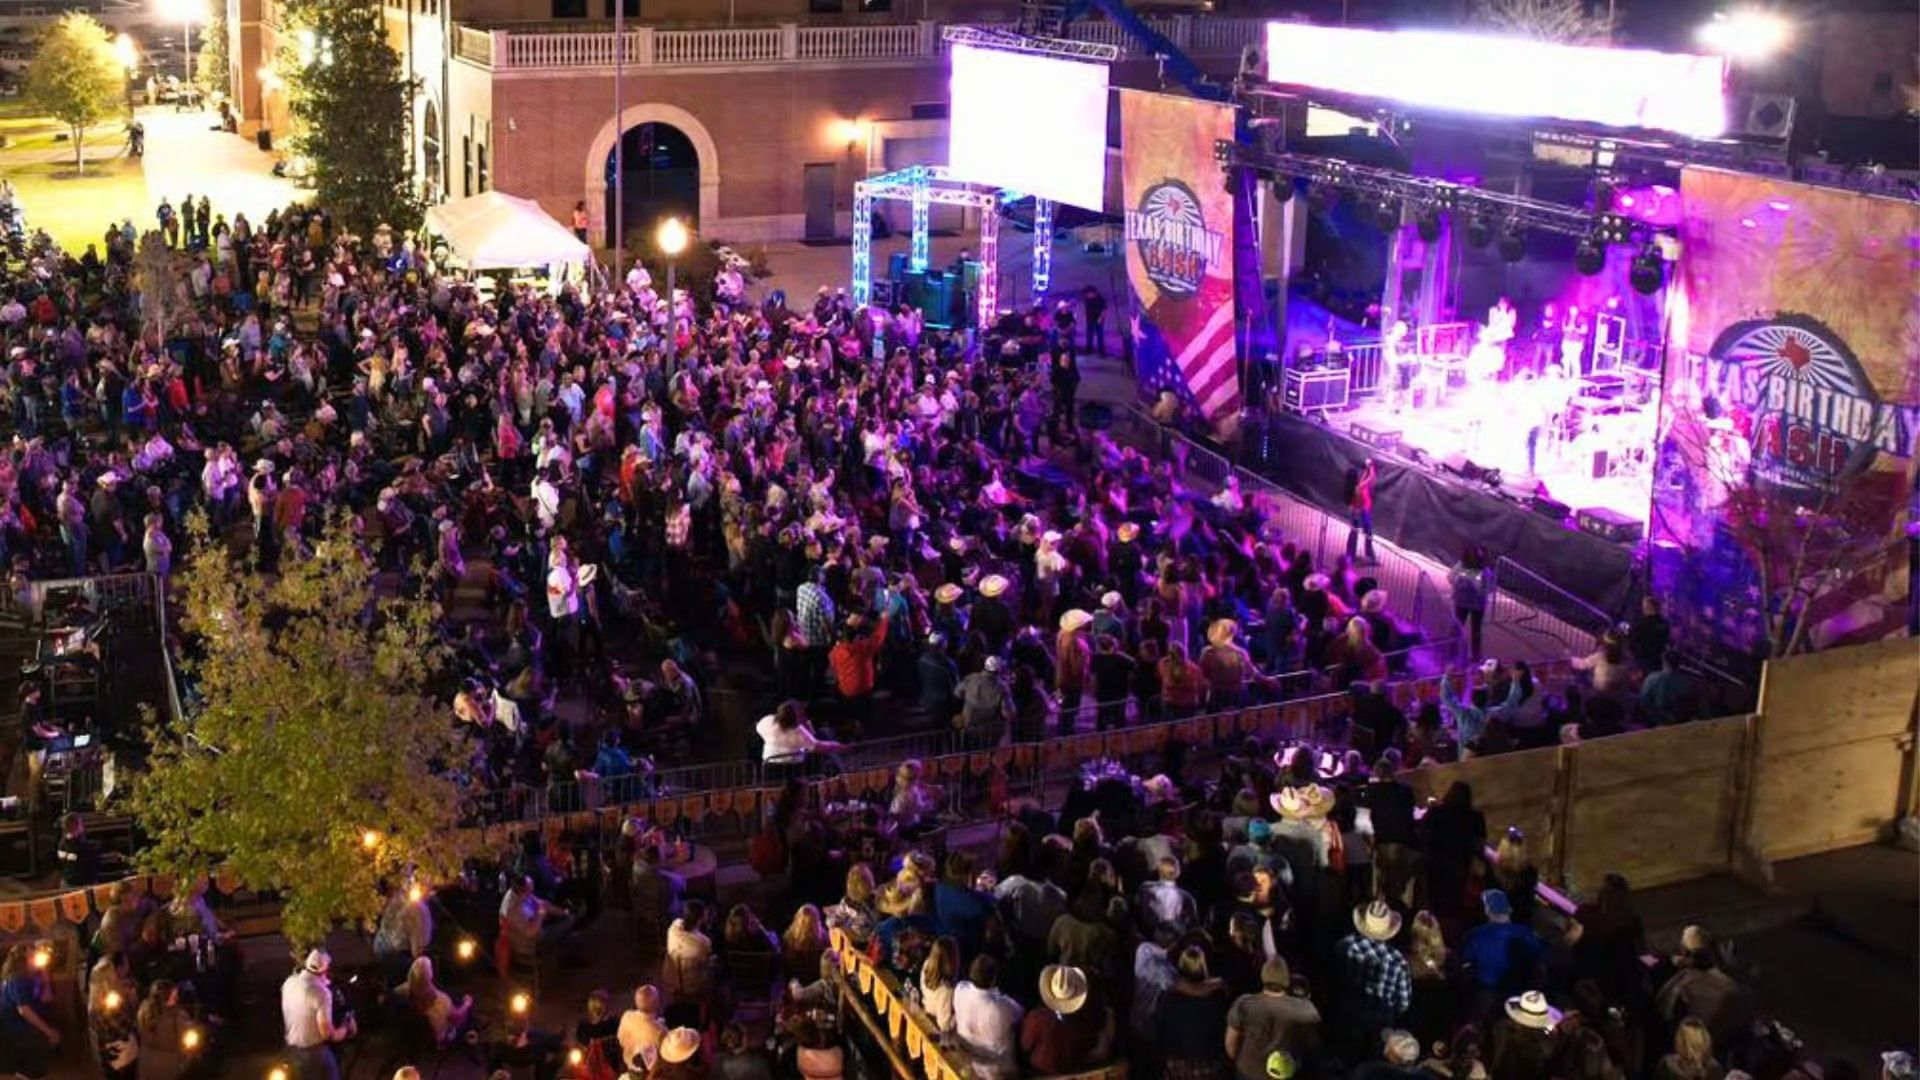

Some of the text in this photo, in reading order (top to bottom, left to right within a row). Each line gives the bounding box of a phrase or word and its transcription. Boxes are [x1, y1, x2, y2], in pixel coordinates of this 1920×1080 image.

[1125, 210, 1160, 240] TEXAS
[1749, 410, 1848, 479] ASH
[1766, 372, 1920, 456] BIRTHDAY
